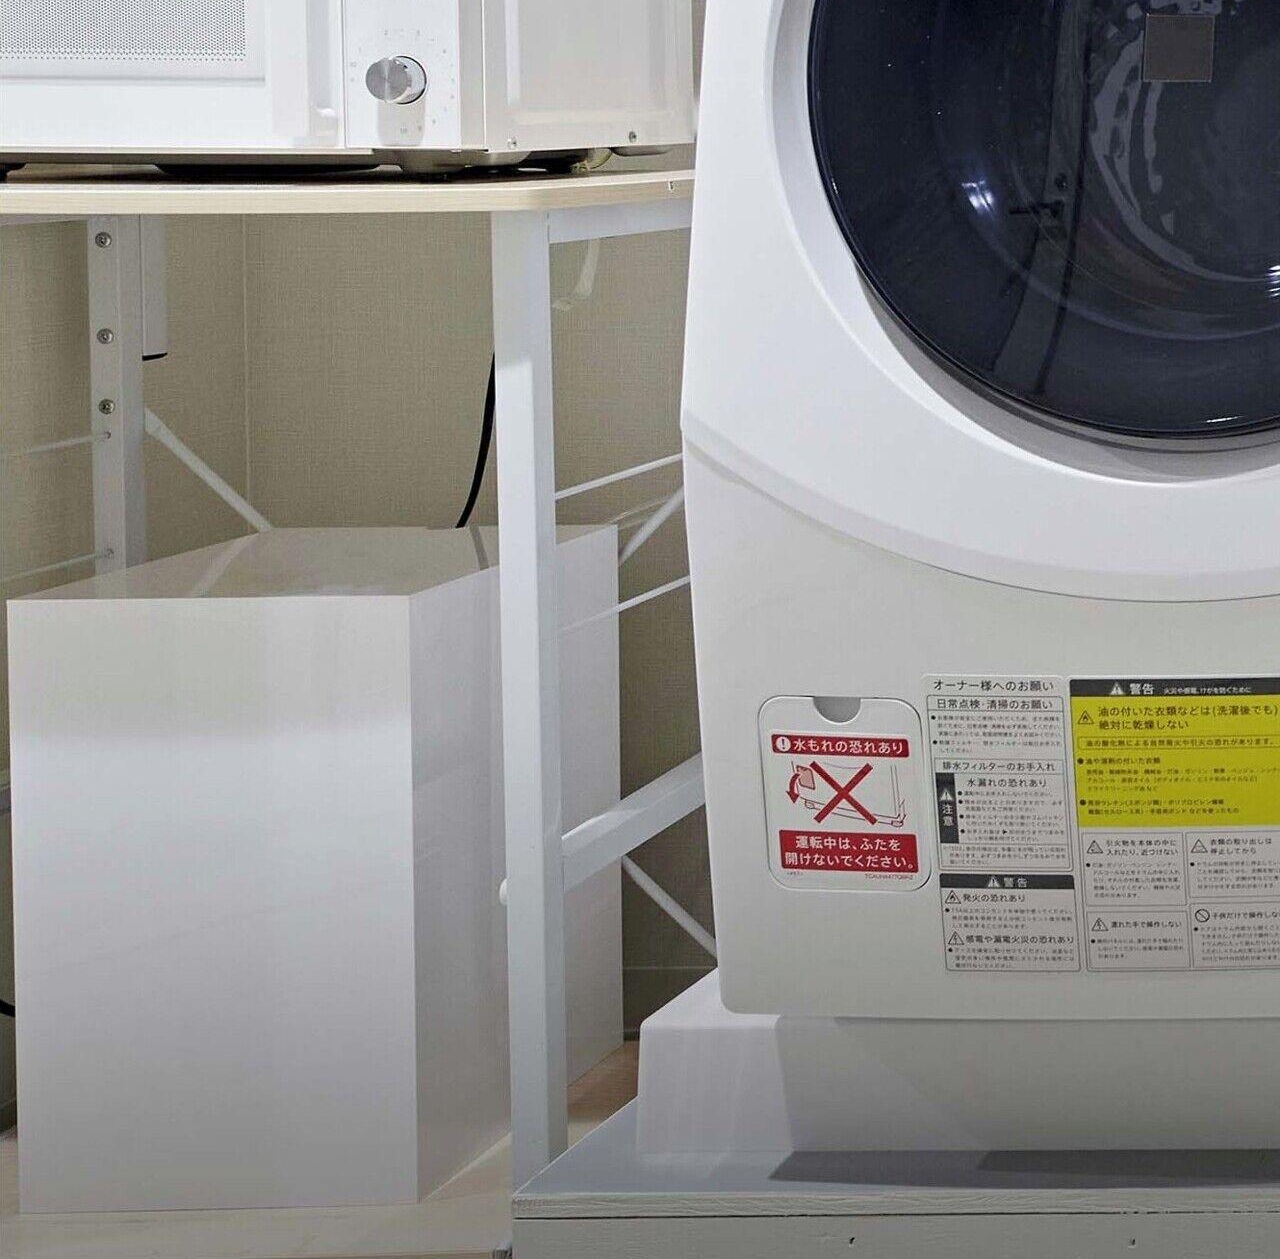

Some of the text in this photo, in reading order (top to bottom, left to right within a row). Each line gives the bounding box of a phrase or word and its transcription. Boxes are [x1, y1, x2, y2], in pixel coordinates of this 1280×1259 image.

[933, 679, 1055, 692] オーナー様へのお願い
[1129, 682, 1155, 695] 警告
[1098, 704, 1279, 717] 油の付いた衣類などは（洗濯後でも）
[1098, 719, 1190, 731] 絶対に乾燥しない
[793, 739, 904, 755] 水もれの恐れあり
[942, 761, 1056, 771] 排水フィルターのお手入れ
[967, 777, 1048, 788] 水漏れの恐れあり
[795, 835, 901, 852] 運転中は、ふたを
[784, 851, 914, 870] 開けないでください。
